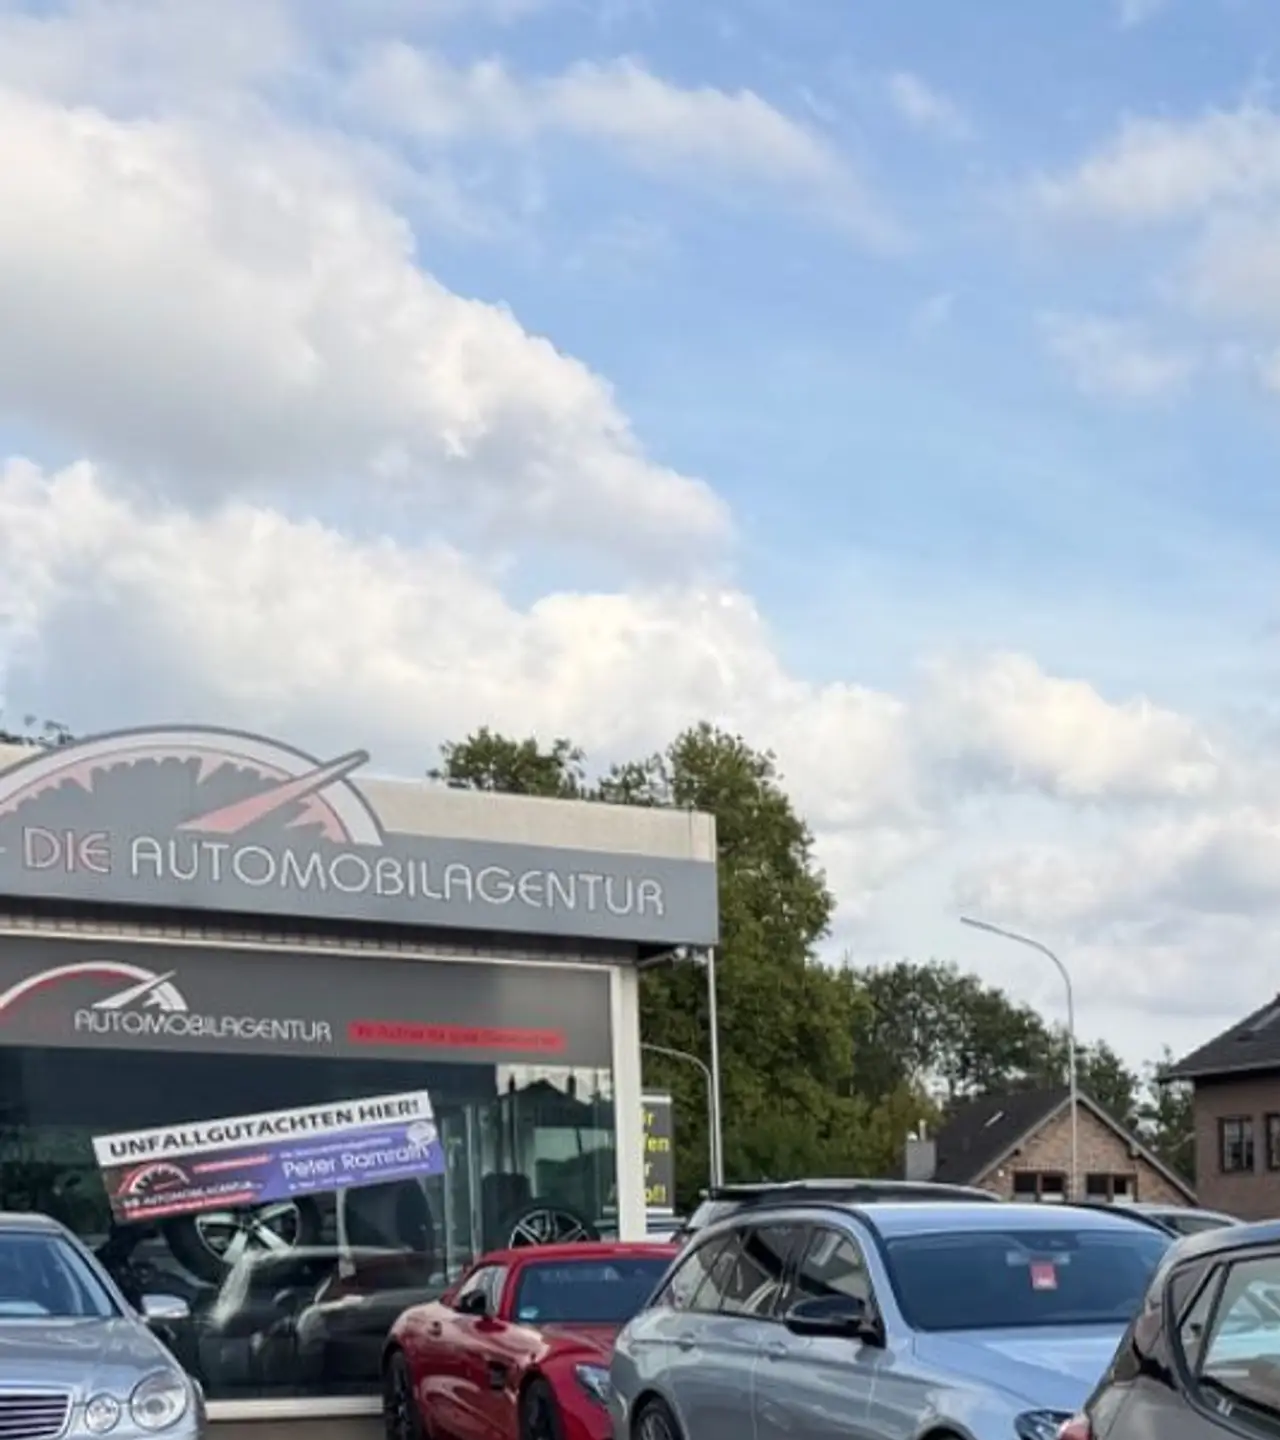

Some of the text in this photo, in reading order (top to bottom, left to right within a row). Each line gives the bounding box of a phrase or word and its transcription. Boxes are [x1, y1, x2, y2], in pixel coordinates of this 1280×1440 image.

[23, 825, 665, 916] DIE AUTOMOBILAGENTUR
[74, 1008, 333, 1043] AUTOMOBILAGENTUR
[110, 1109, 354, 1157] UNFALLGUTACHTEN
[282, 1156, 336, 1179] Peter
